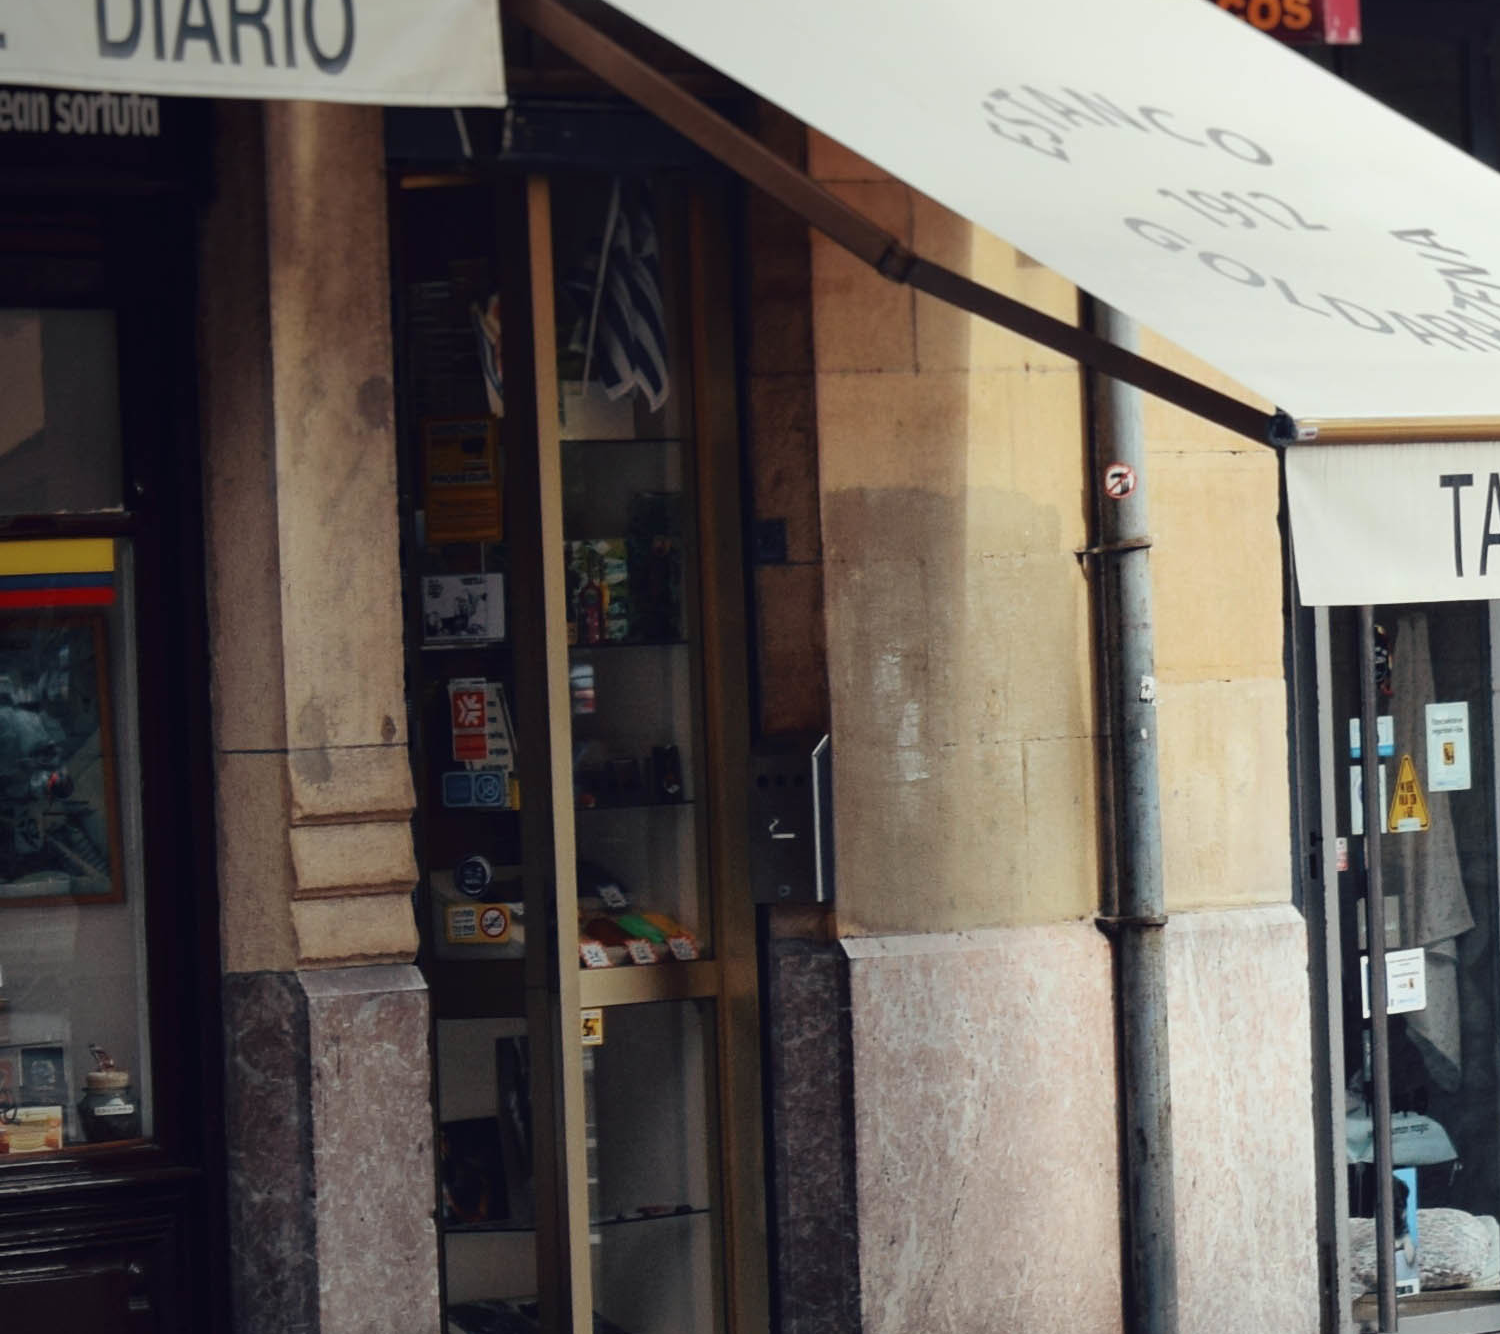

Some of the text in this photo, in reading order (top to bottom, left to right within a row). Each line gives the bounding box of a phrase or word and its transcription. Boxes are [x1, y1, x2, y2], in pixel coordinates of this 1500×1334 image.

[55, 92, 161, 137] sortuta
[981, 84, 1274, 167] ESTANCO
[1156, 187, 1331, 232] 1912
